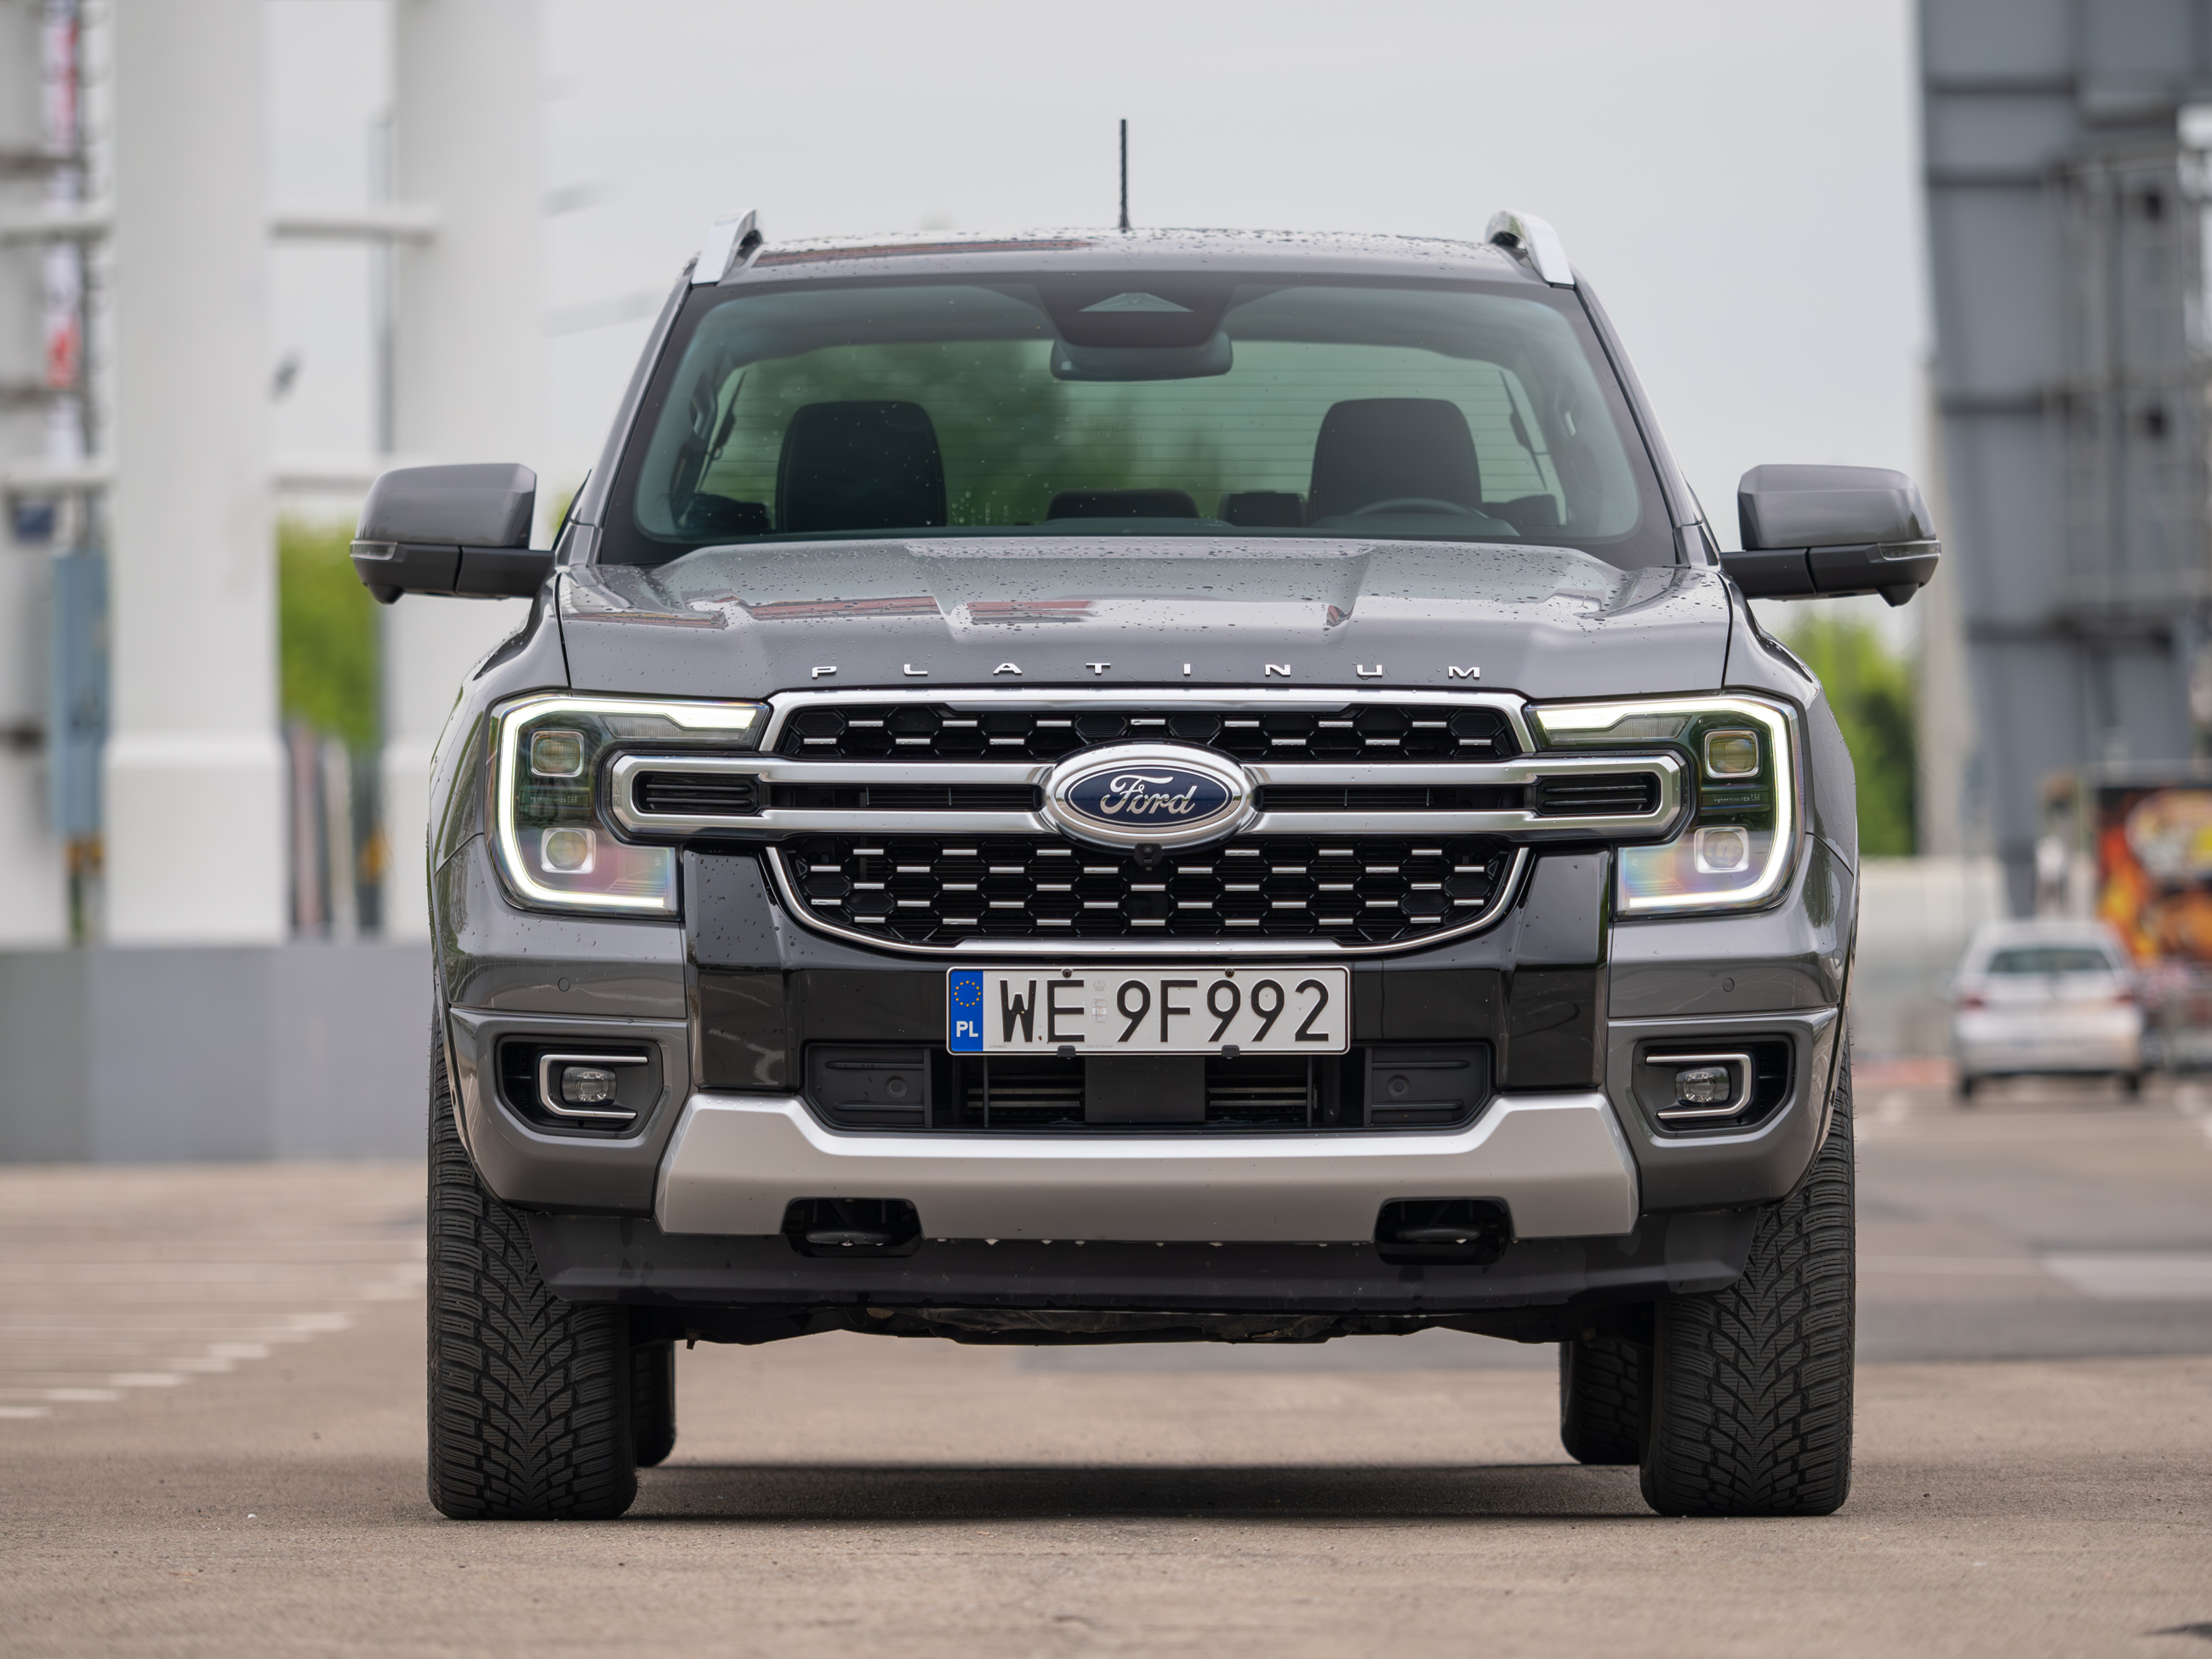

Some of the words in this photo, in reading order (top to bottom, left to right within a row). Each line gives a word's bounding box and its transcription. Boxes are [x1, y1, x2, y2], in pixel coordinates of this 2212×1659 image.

[811, 662, 1480, 679] PLATINUM
[1099, 774, 1198, 814] Ford
[999, 979, 1086, 1043] WE
[1116, 978, 1330, 1043] 9F992
[955, 1021, 979, 1038] PL
